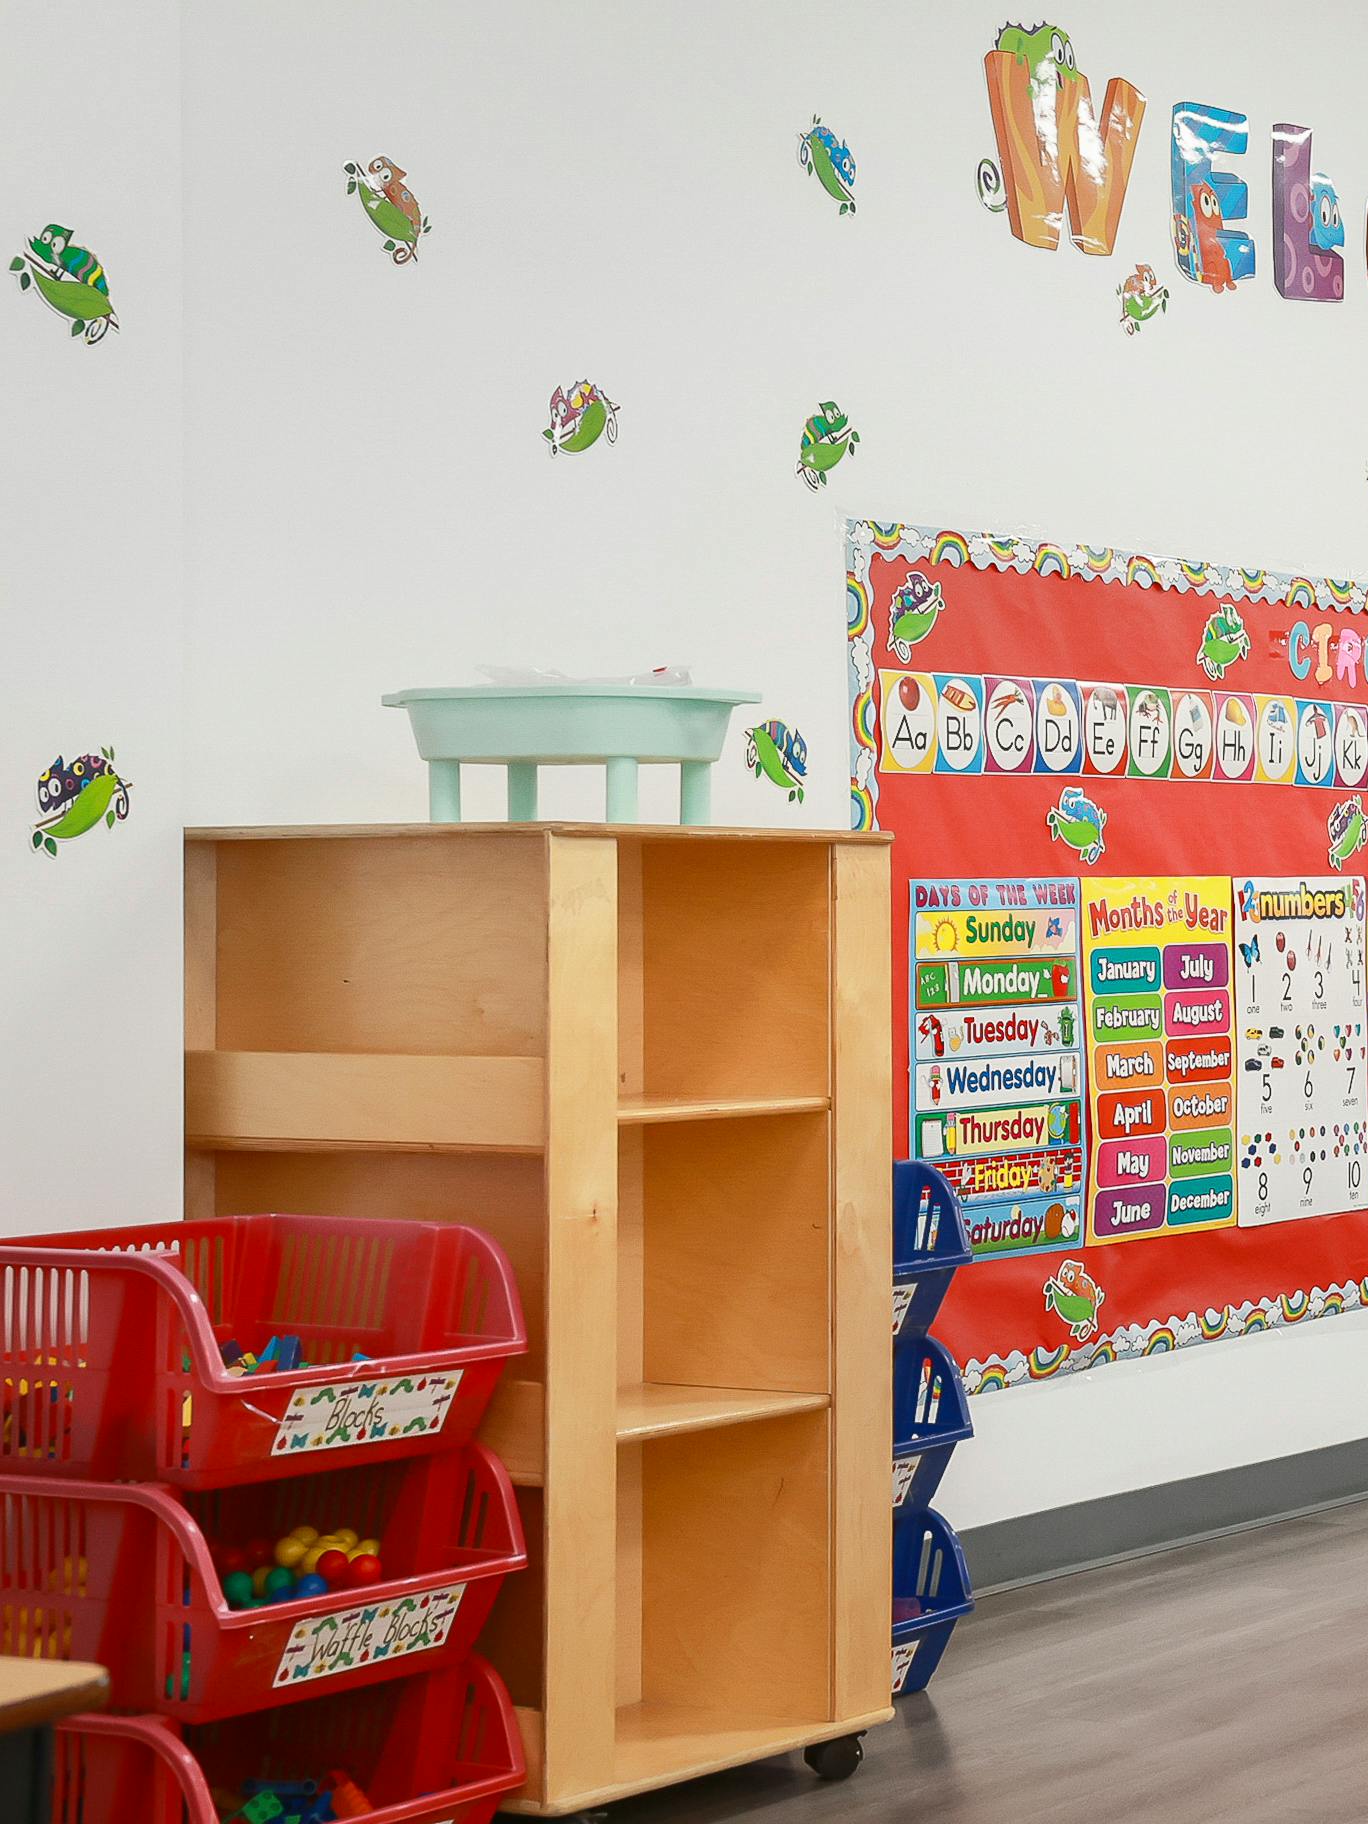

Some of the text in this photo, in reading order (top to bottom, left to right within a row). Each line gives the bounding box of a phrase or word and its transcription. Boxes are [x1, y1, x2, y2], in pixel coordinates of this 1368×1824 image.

[892, 714, 927, 750] Aa
[946, 716, 973, 751] Bb
[996, 718, 1024, 751] Cc
[1044, 719, 1072, 753] Dd
[1092, 723, 1115, 755] Ee
[1139, 725, 1160, 758] Ff
[1178, 728, 1202, 772] Gg
[1222, 730, 1246, 762] Hh
[1269, 732, 1282, 764] Ii
[1304, 737, 1322, 781] Jj
[1342, 740, 1362, 770] Kk
[915, 883, 1076, 907] DAYS OF THE WEEK
[1260, 881, 1346, 920] numbers
[1088, 890, 1227, 937] Months of the Year
[966, 913, 1036, 948] Sunday
[963, 963, 1040, 998] Monday
[1097, 957, 1156, 983] January
[1180, 954, 1214, 982] July
[1282, 973, 1292, 1001] 2
[1314, 971, 1324, 999] 3
[1351, 969, 1361, 996] 4
[1096, 1006, 1160, 1030] February
[1172, 999, 1223, 1025] August
[1246, 1005, 1260, 1014] one
[1280, 1002, 1293, 1012] two
[963, 1012, 1039, 1047] Tuesday
[1106, 1051, 1154, 1078] March
[1168, 1050, 1230, 1076] September
[946, 1060, 1057, 1095] Wednesday
[1262, 1073, 1272, 1101] 5
[1304, 1070, 1313, 1098] 6
[1346, 1067, 1356, 1094] 7
[1113, 1100, 1152, 1134] April
[1173, 1093, 1228, 1117] October
[959, 1111, 1045, 1145] Thursday
[1117, 1151, 1149, 1178] May
[1172, 1143, 1230, 1165] November
[974, 1160, 1033, 1192] Friday
[1258, 1172, 1268, 1201] 8
[1303, 1167, 1313, 1195] 9
[1348, 1160, 1361, 1188] 10
[1110, 1200, 1151, 1226] June
[1170, 1189, 1230, 1213] December
[1255, 1204, 1271, 1217] eight
[325, 1396, 385, 1431] Blocks
[309, 1607, 439, 1666] Waffle Blocks
